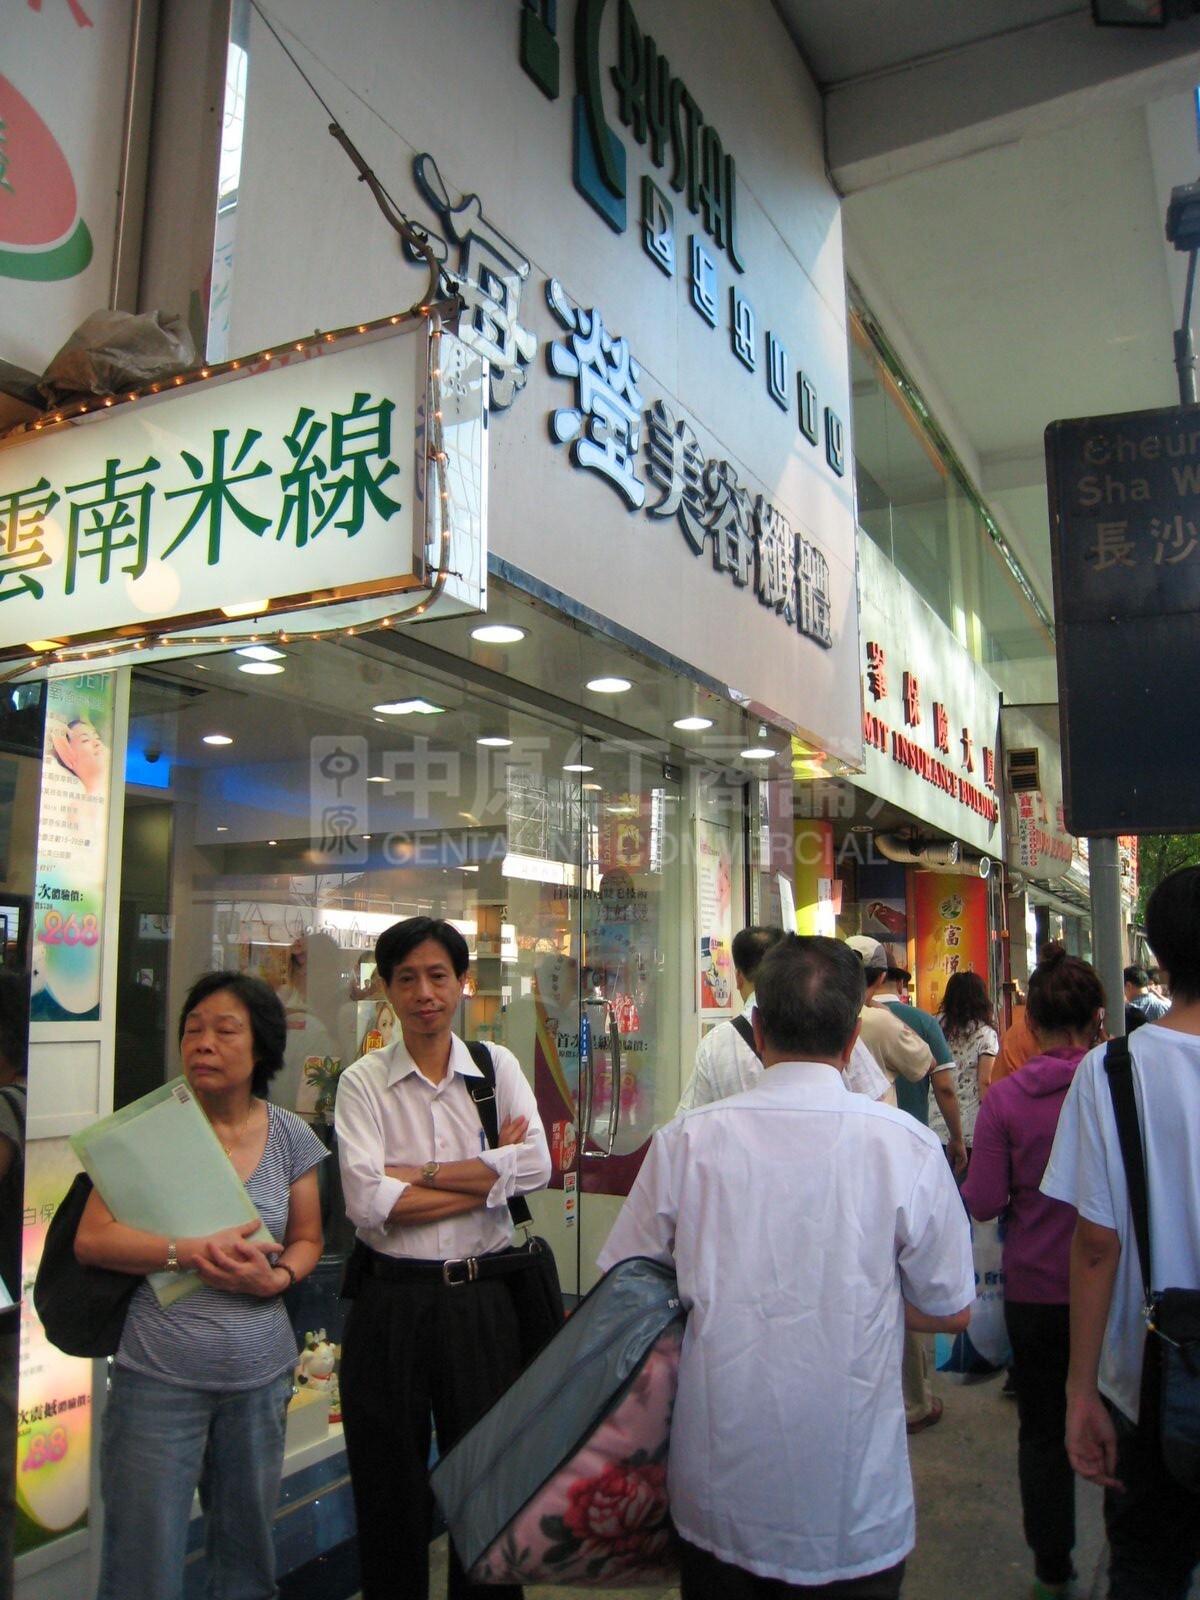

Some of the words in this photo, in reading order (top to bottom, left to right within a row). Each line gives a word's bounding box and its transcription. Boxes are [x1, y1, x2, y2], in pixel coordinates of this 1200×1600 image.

[641, 174, 844, 478] BEAUTY
[0, 391, 402, 602] 雲南米線
[1077, 473, 1151, 507] Sha
[1089, 515, 1199, 572] 長沙
[892, 730, 958, 799] INSURANCE
[958, 777, 999, 824] BUILDING
[38, 911, 99, 947] 268
